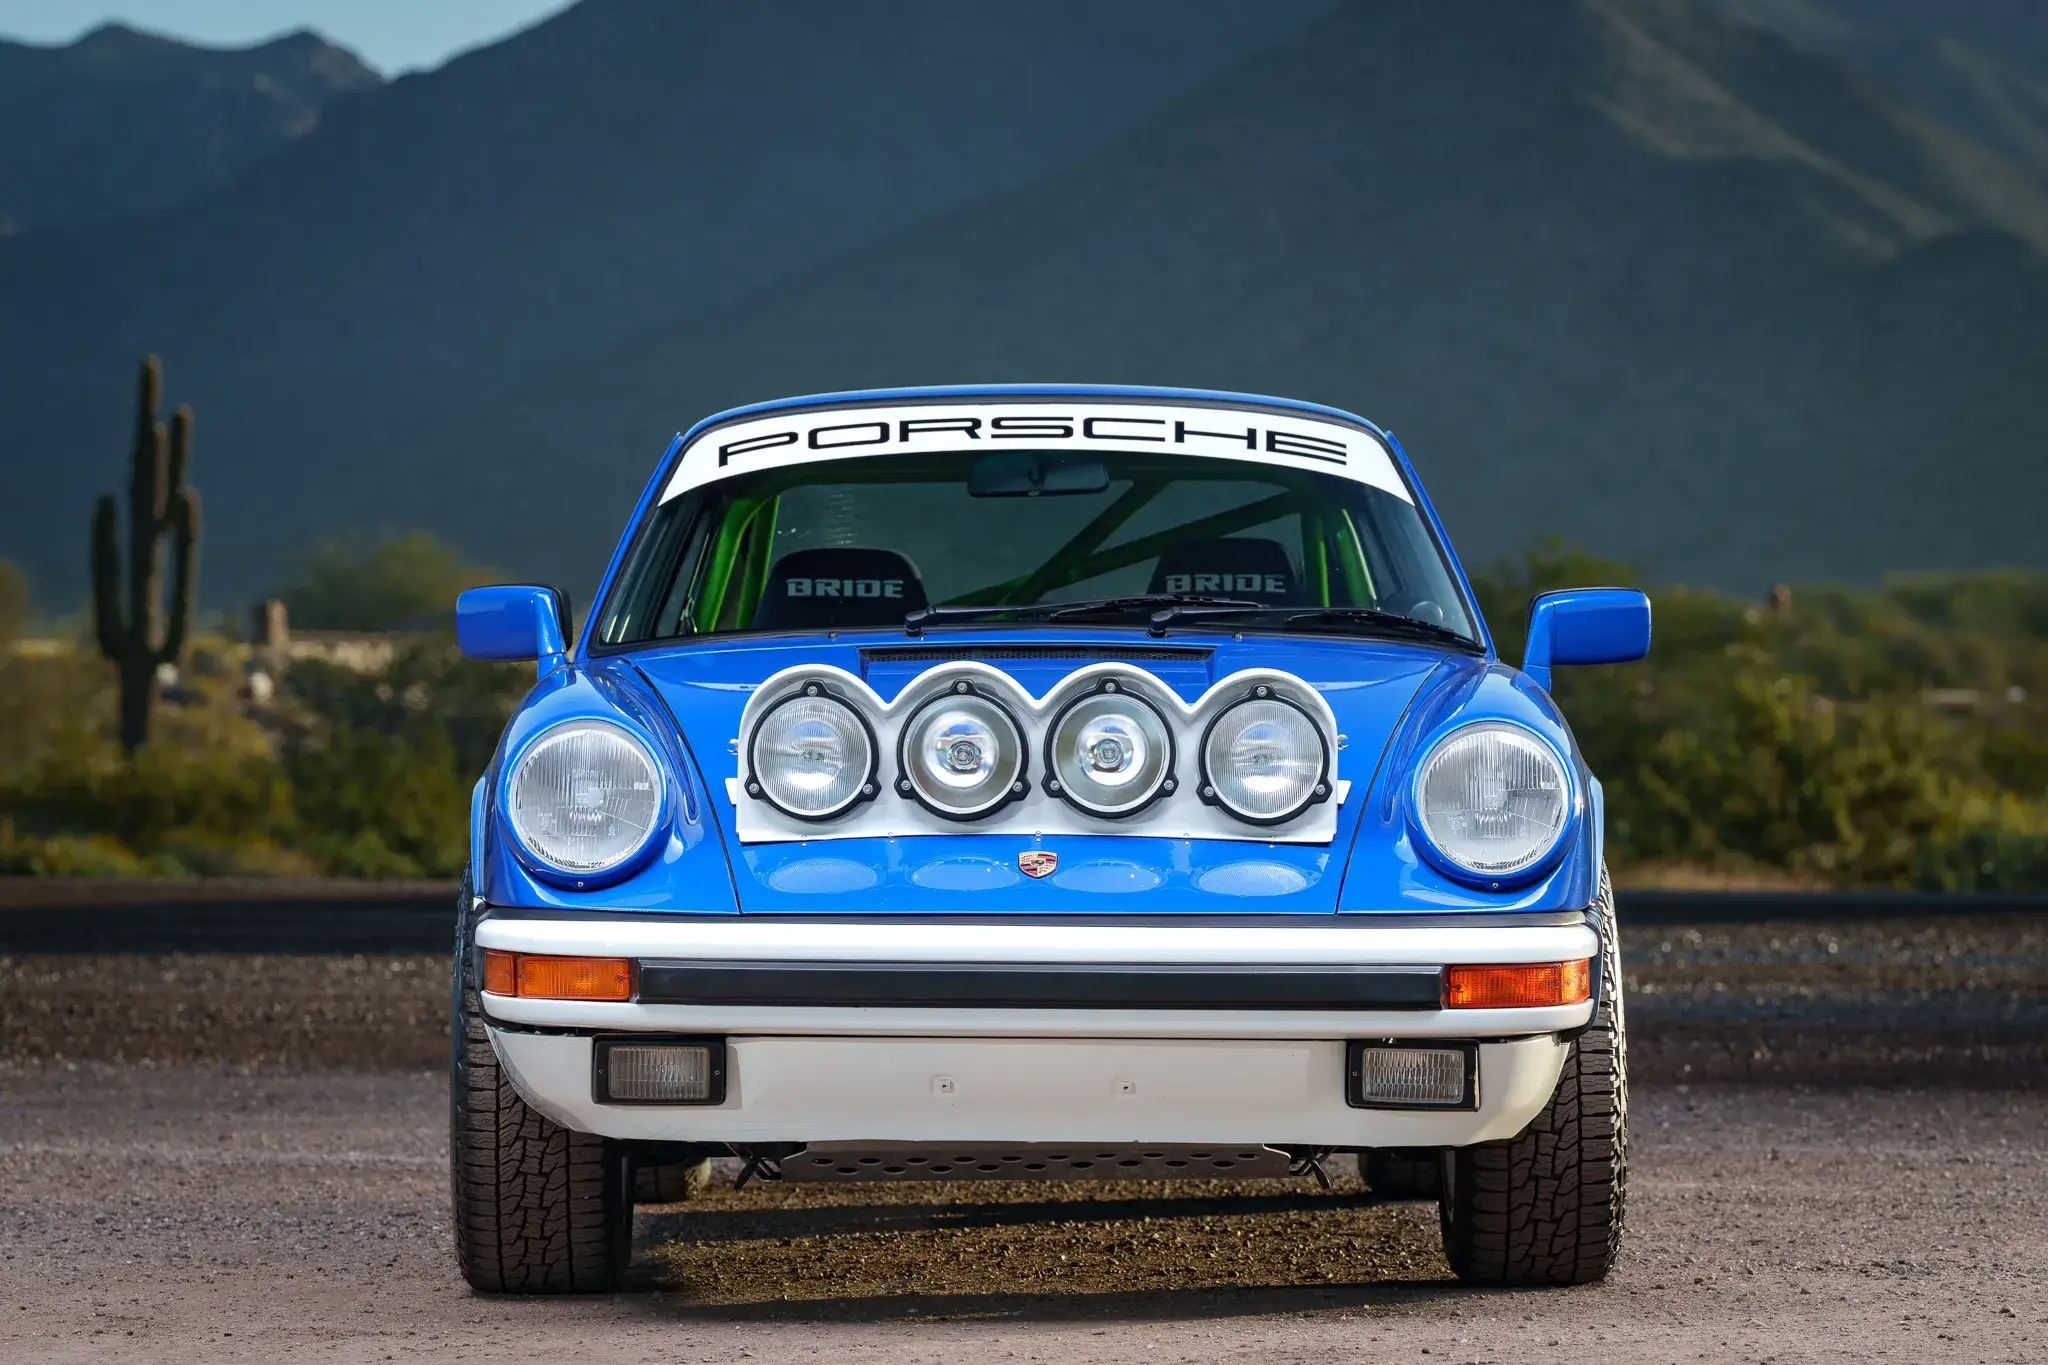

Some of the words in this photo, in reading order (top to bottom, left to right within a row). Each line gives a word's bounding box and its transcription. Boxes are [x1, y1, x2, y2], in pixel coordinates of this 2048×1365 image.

[718, 416, 1347, 468] PORSCHE
[786, 578, 904, 597] BRIDE
[1165, 574, 1286, 593] BRIDE
